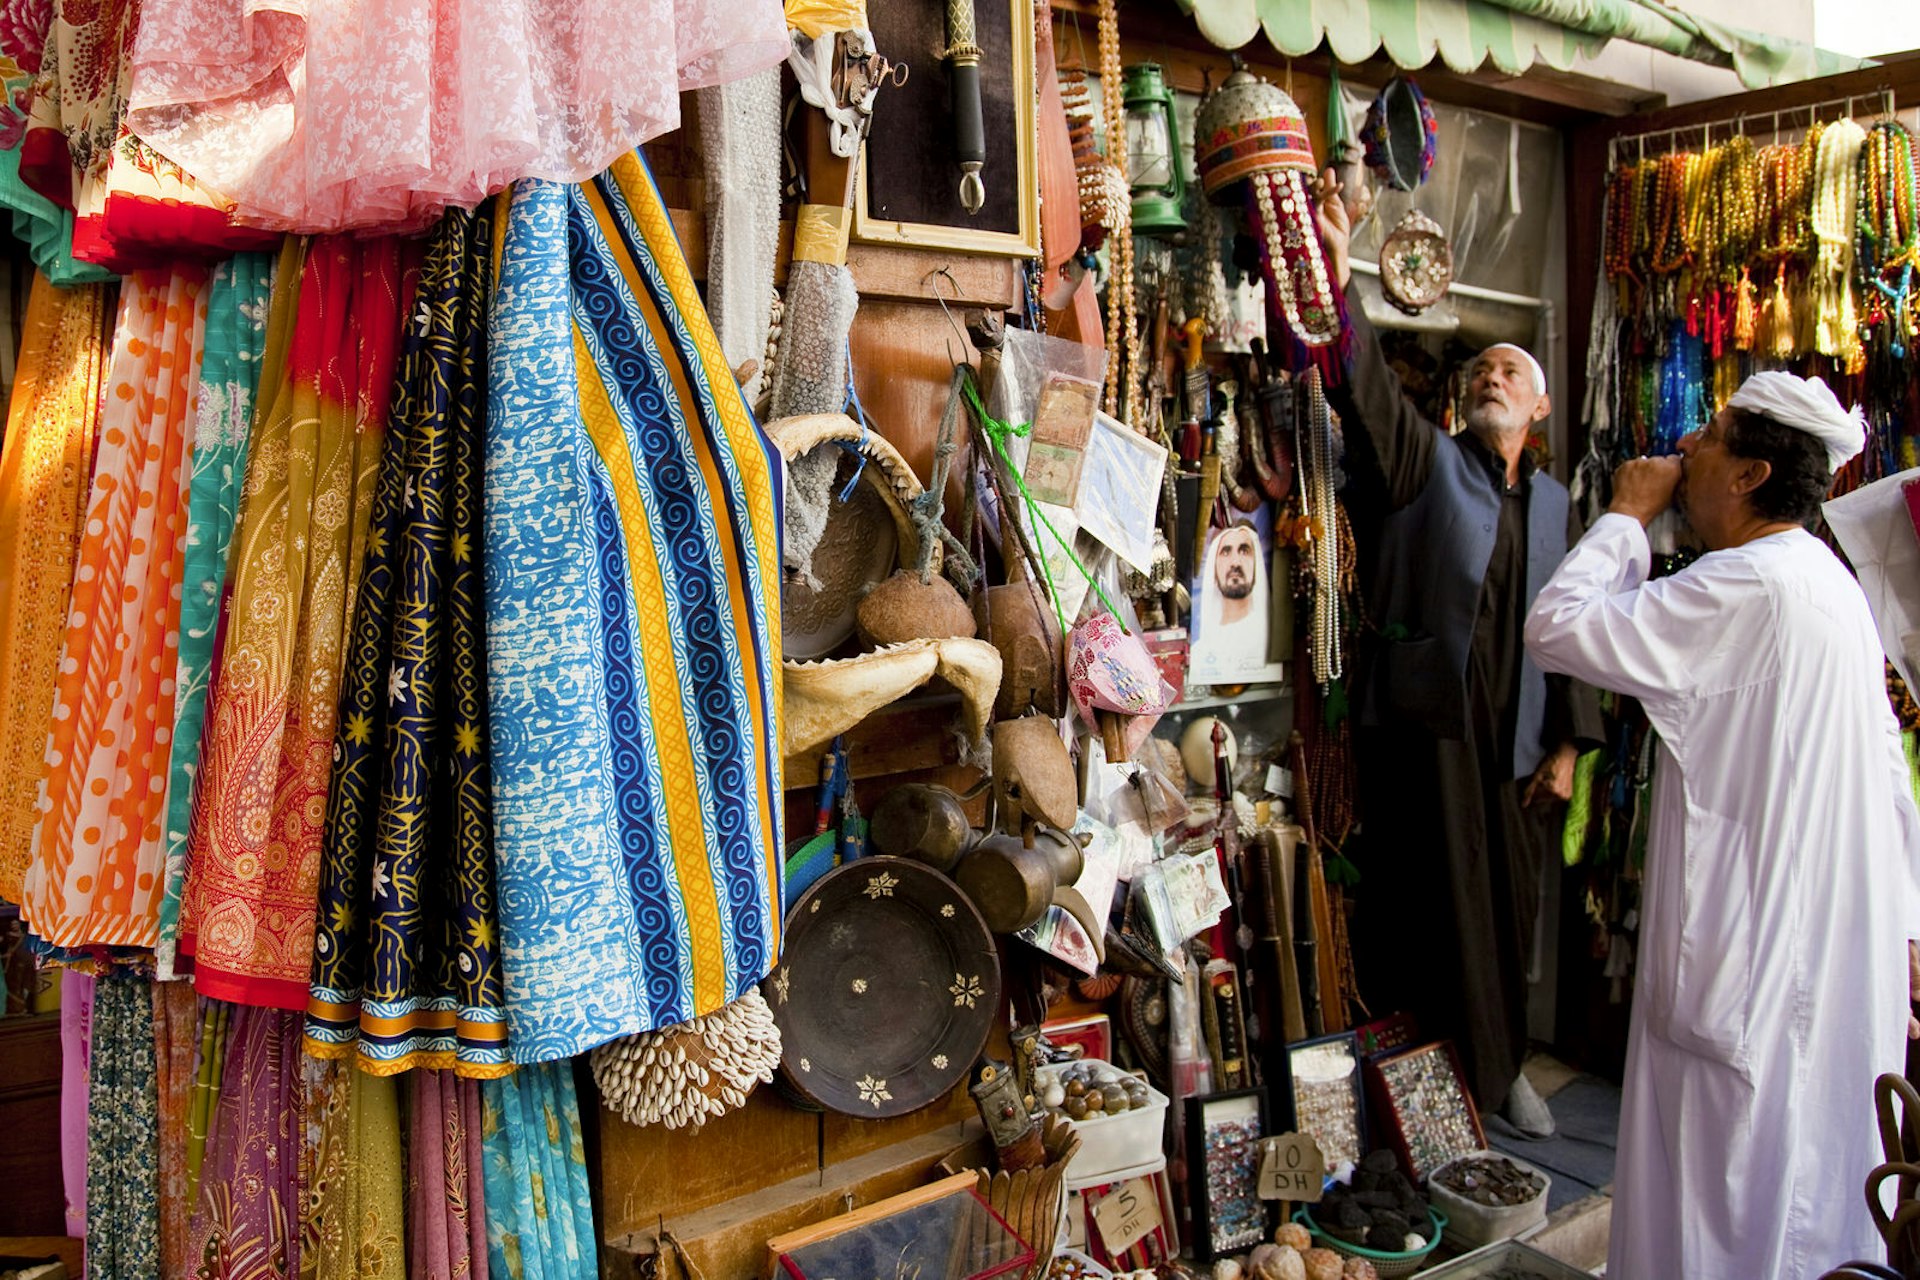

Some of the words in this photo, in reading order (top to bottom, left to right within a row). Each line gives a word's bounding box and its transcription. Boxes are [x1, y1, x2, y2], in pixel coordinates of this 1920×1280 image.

[1275, 1145, 1301, 1168] 10
[1275, 1173, 1308, 1190] DH
[1119, 1190, 1137, 1218] 5
